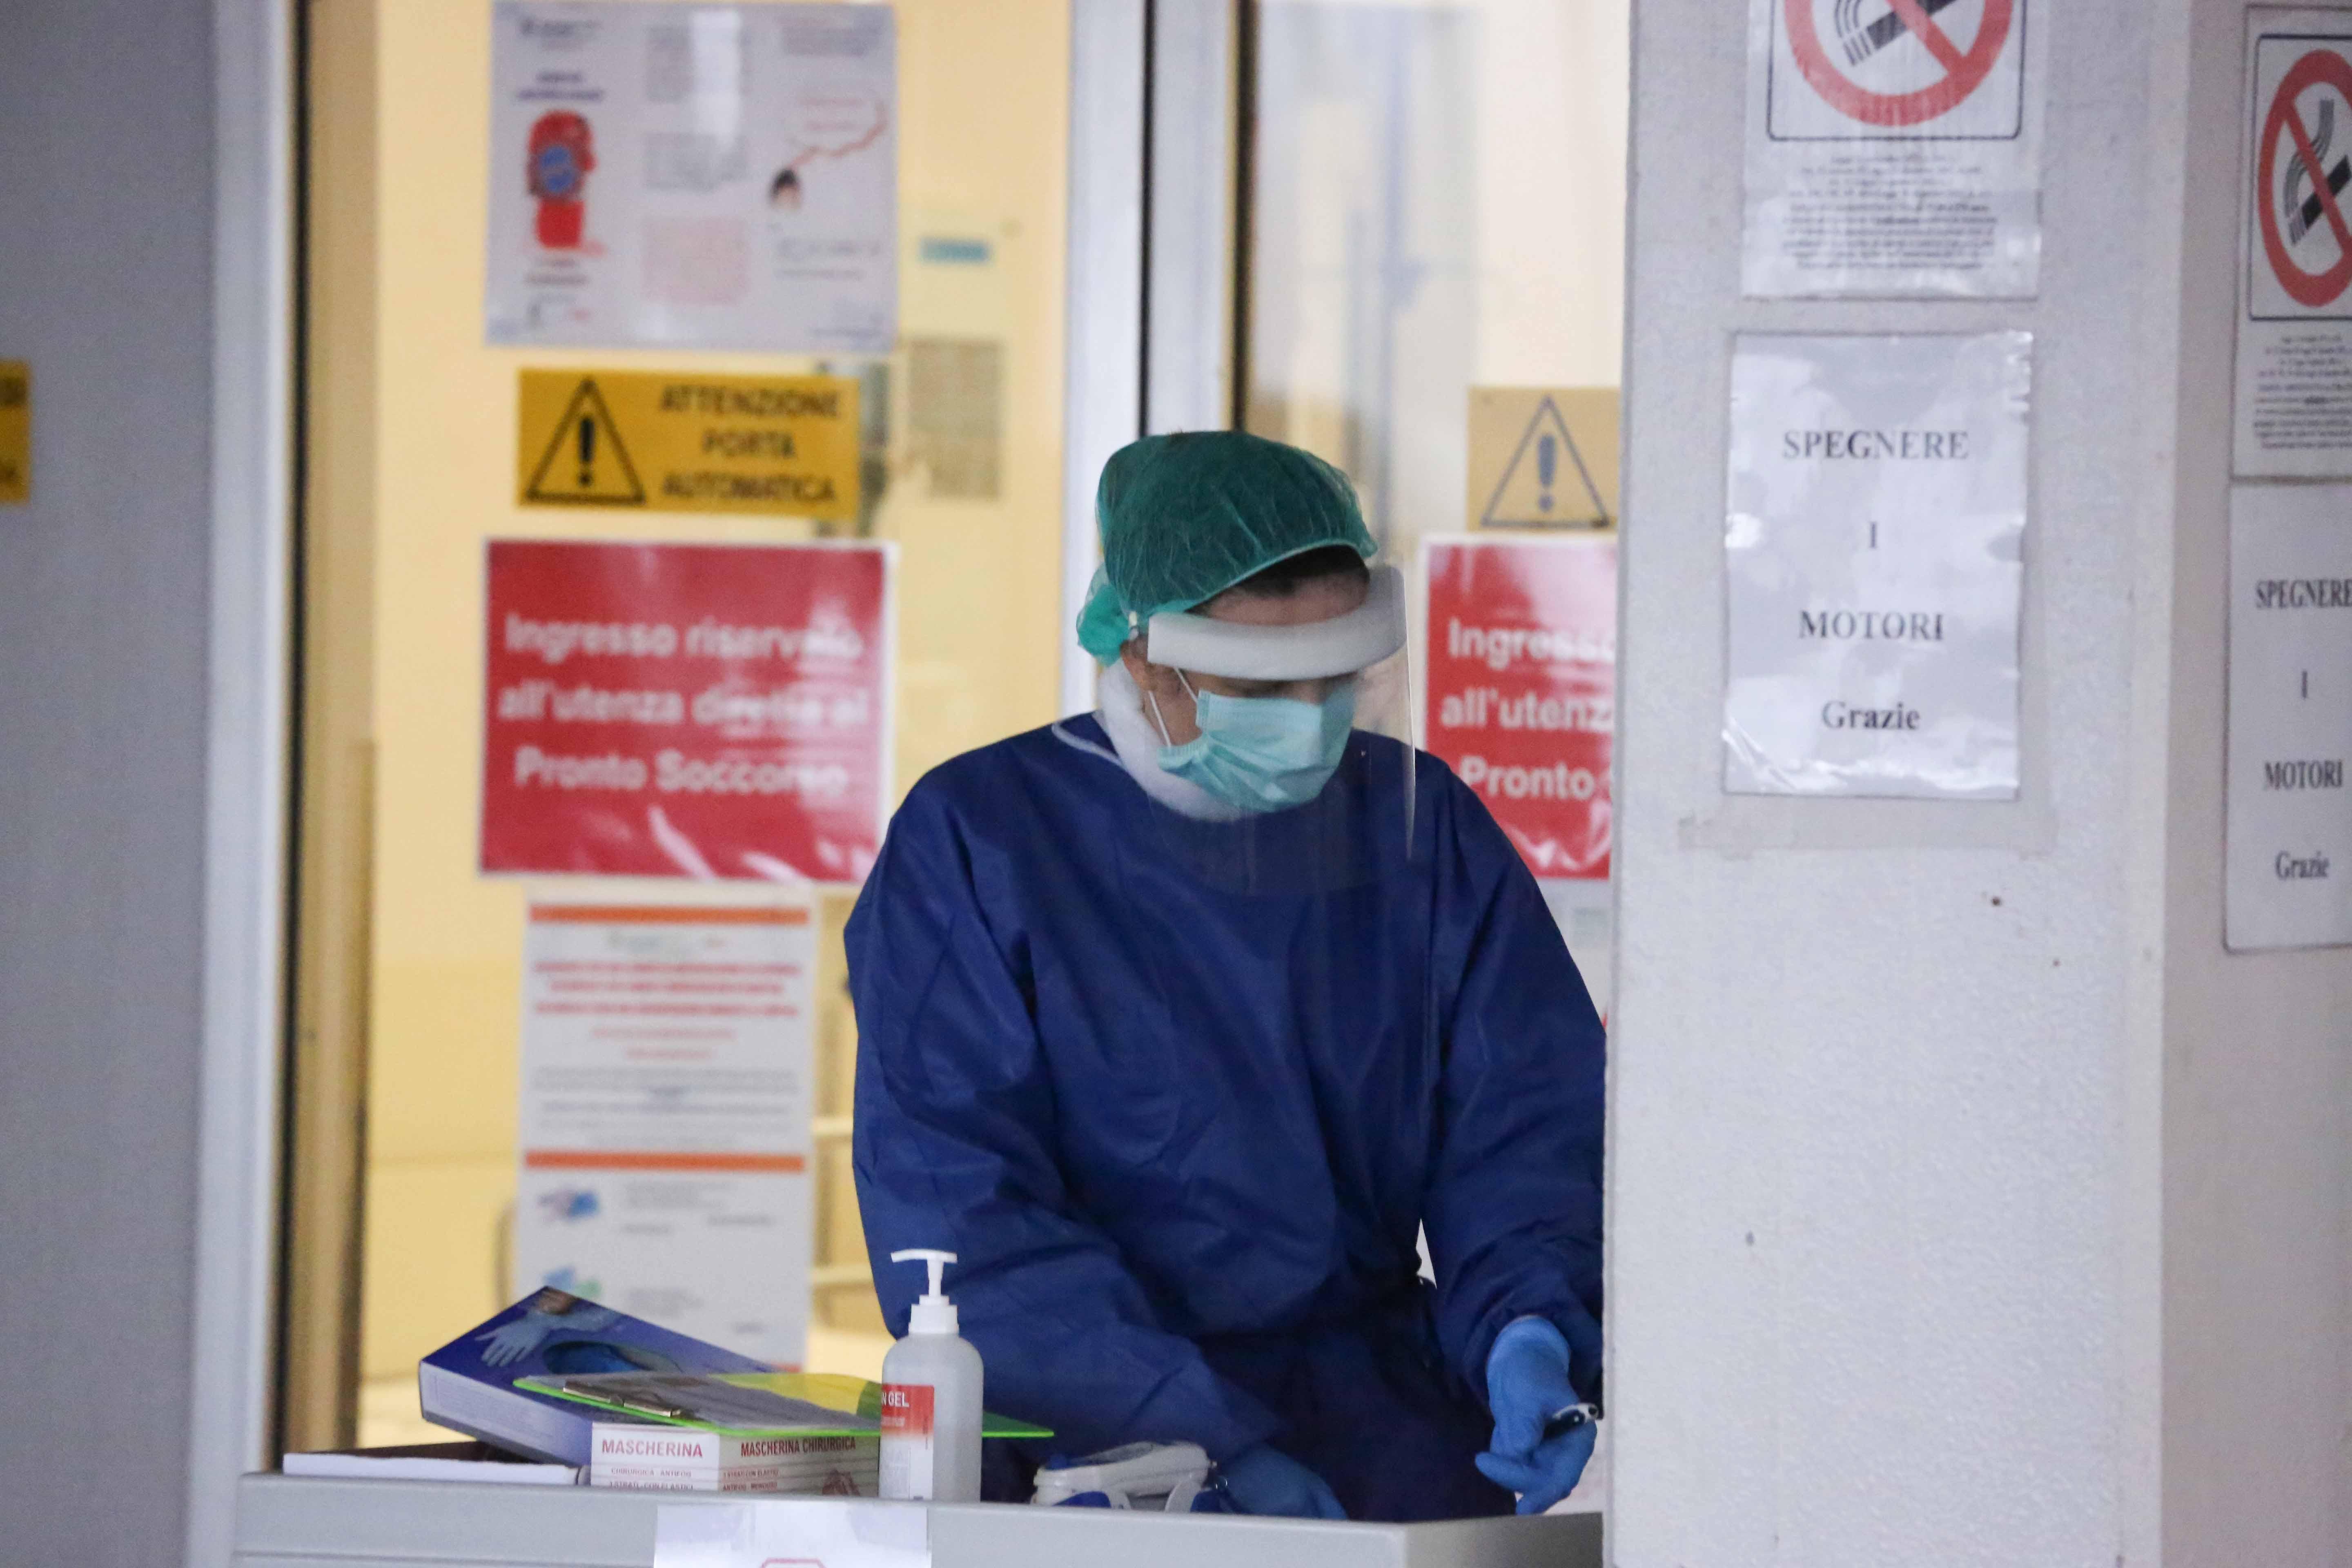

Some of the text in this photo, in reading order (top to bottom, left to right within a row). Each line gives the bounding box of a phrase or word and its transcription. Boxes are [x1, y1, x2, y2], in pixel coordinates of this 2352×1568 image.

[1783, 430, 1969, 459] SPEGNERE
[1869, 521, 1878, 548] I
[2256, 579, 2352, 608] SPEGNERE
[506, 614, 678, 664] Ingresso
[1799, 610, 1944, 640] MOTORI
[2301, 670, 2310, 699] I
[1440, 686, 1615, 732] all'utenz
[1822, 701, 1920, 730] Grazie
[515, 746, 648, 791] Pronto
[1460, 754, 1595, 800] Pronto
[2265, 760, 2344, 790] MOTORI
[2276, 850, 2330, 880] Grazie
[888, 1391, 910, 1408] GEL
[602, 1439, 703, 1458] MASCHERINA
[741, 1437, 856, 1457] MASCHERINA CHIRURGICA
